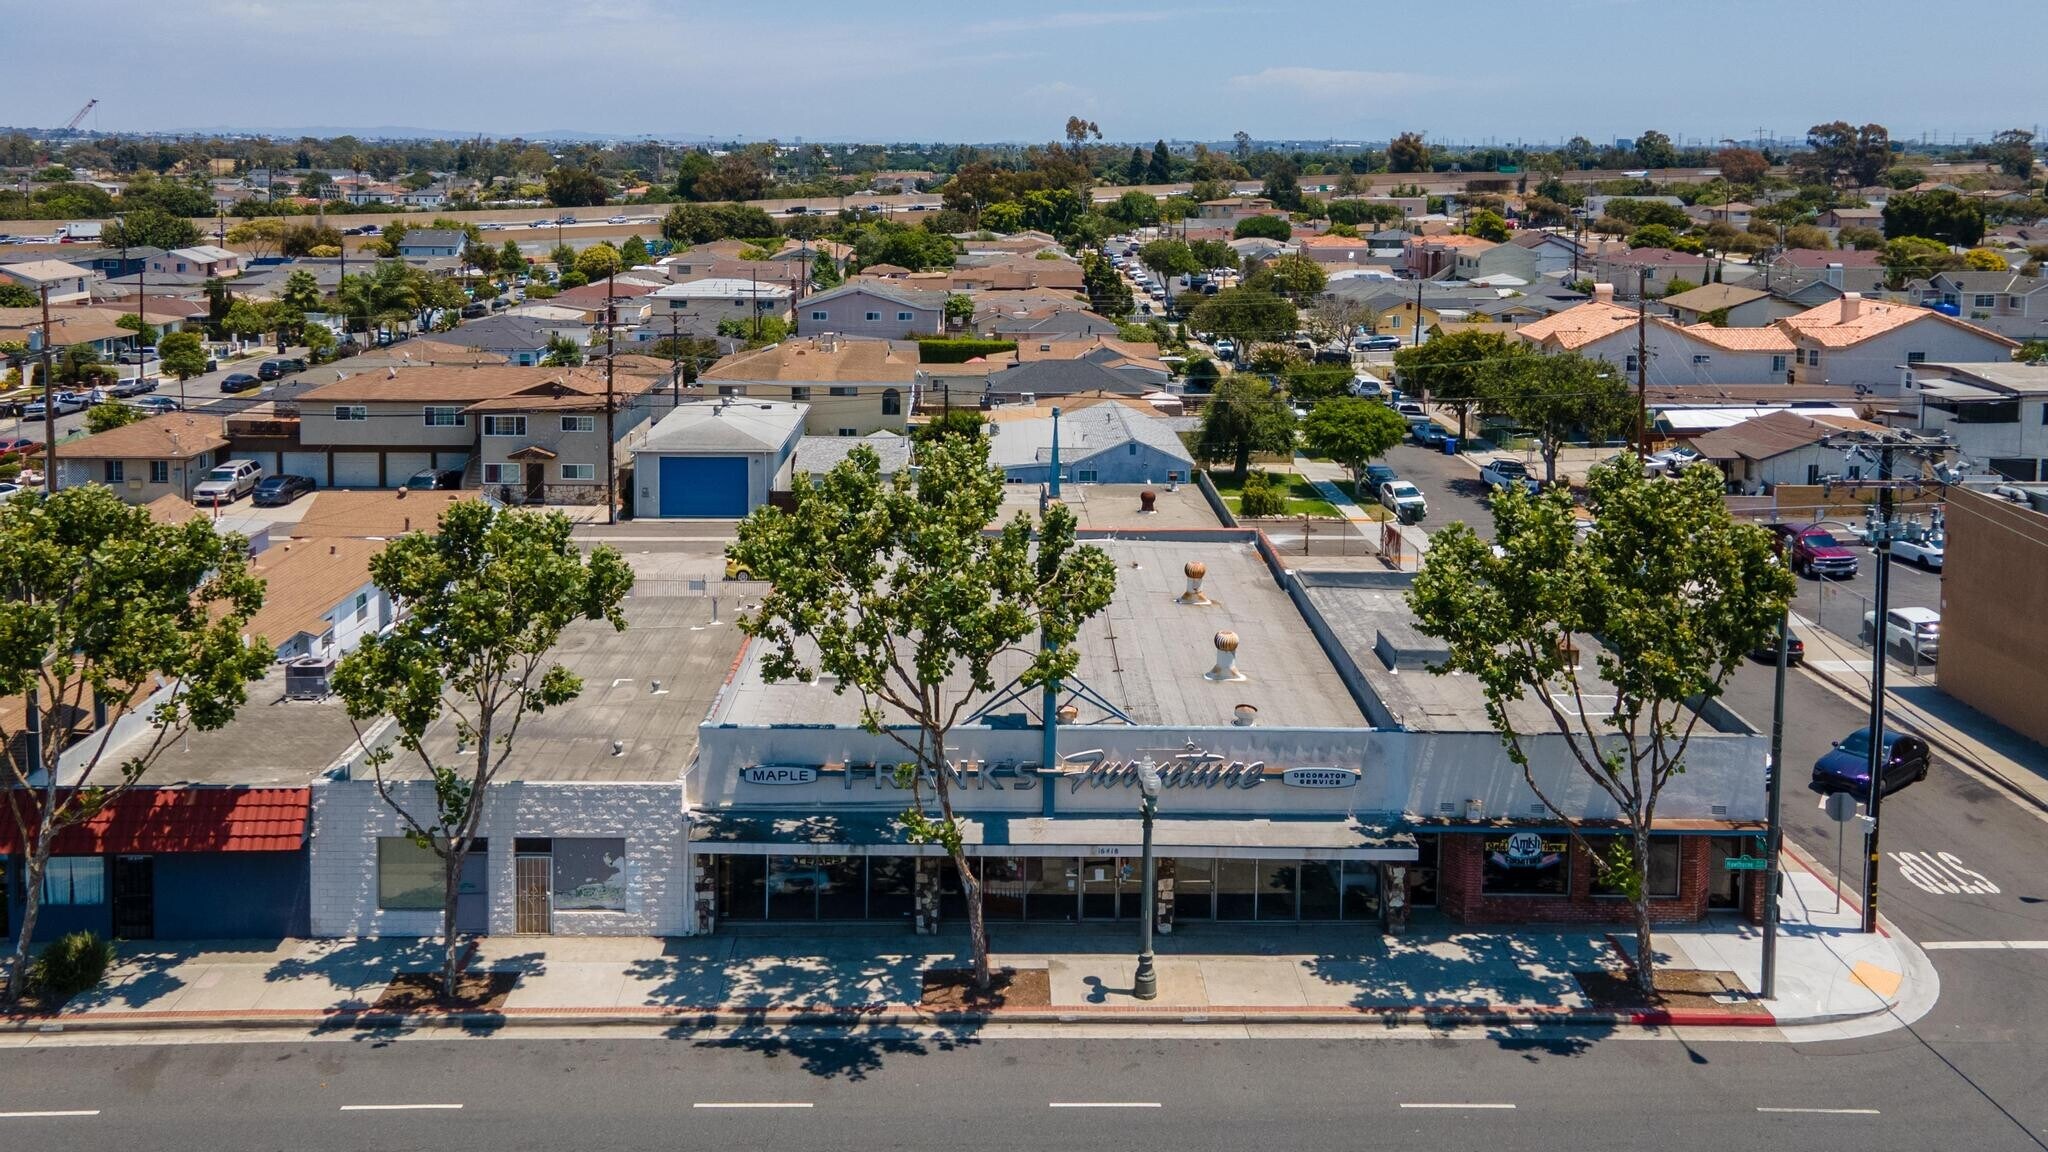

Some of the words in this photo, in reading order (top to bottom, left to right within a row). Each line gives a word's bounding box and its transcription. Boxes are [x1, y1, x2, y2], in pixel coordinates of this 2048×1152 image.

[753, 770, 809, 781] MAPLE
[1509, 836, 1541, 853] Amish
[1886, 851, 2001, 894] BUS
